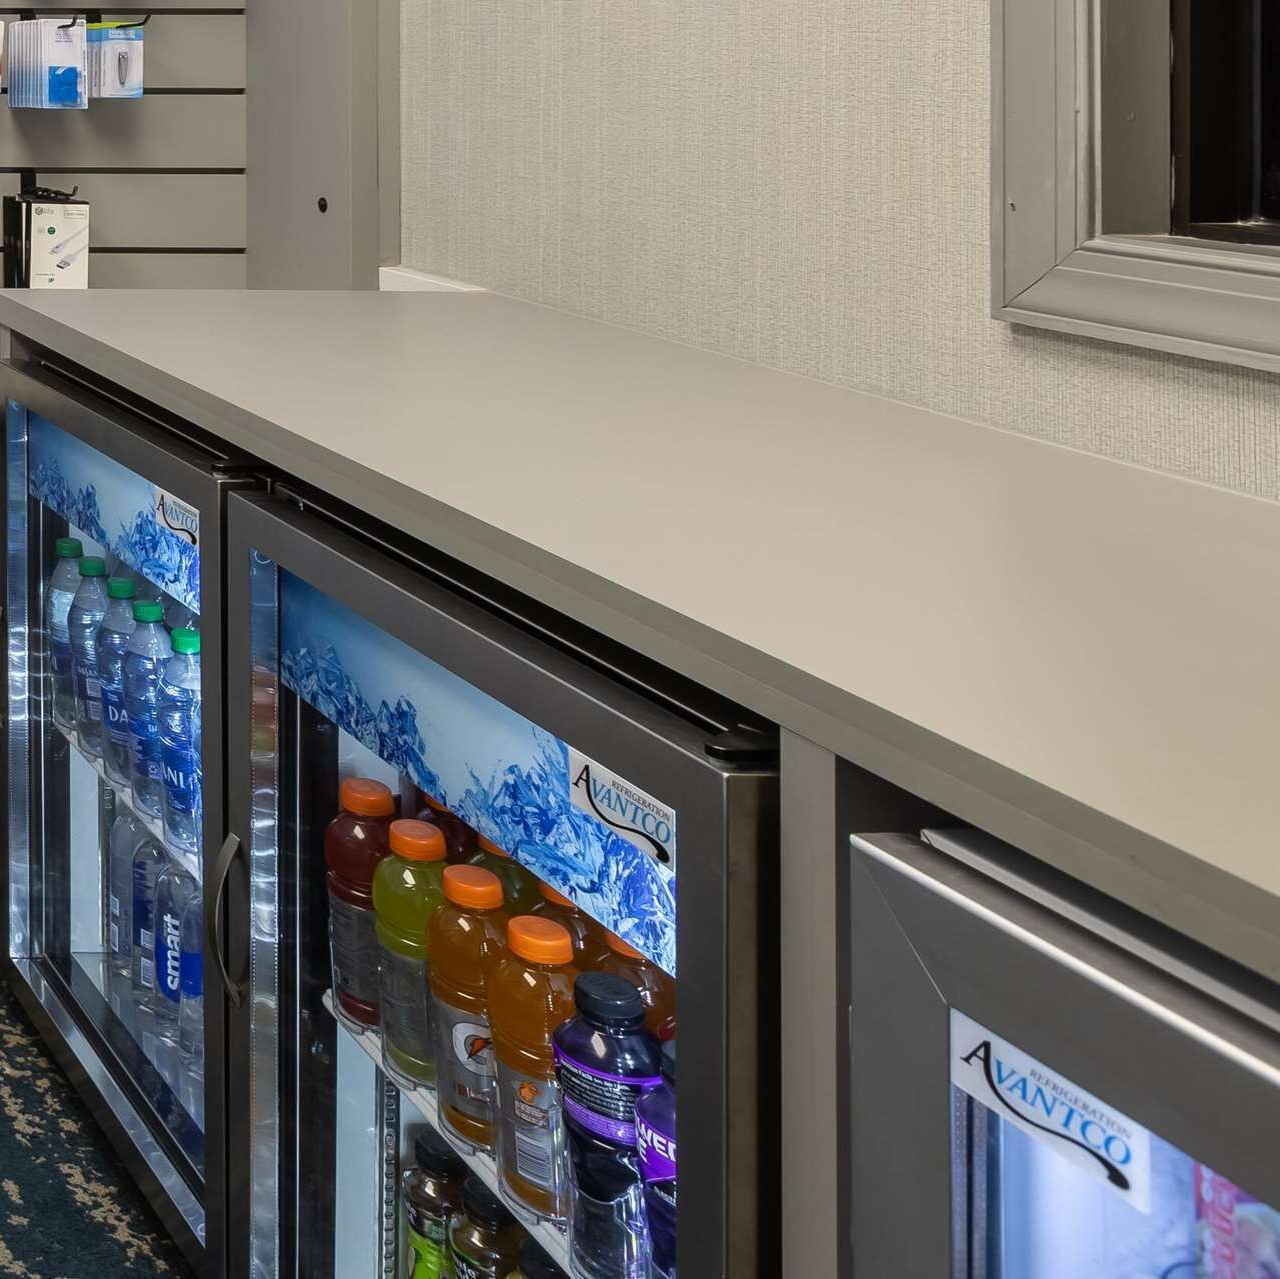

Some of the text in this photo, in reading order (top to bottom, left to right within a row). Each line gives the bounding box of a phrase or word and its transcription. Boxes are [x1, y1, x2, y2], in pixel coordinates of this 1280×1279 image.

[157, 494, 199, 536] AVANTCO
[572, 764, 672, 850] AVANTCO
[611, 779, 671, 823] REFRIGERATION
[163, 913, 183, 991] smart
[959, 1040, 1132, 1170] AVANTCO
[1029, 1067, 1132, 1141] REFRIGERATION
